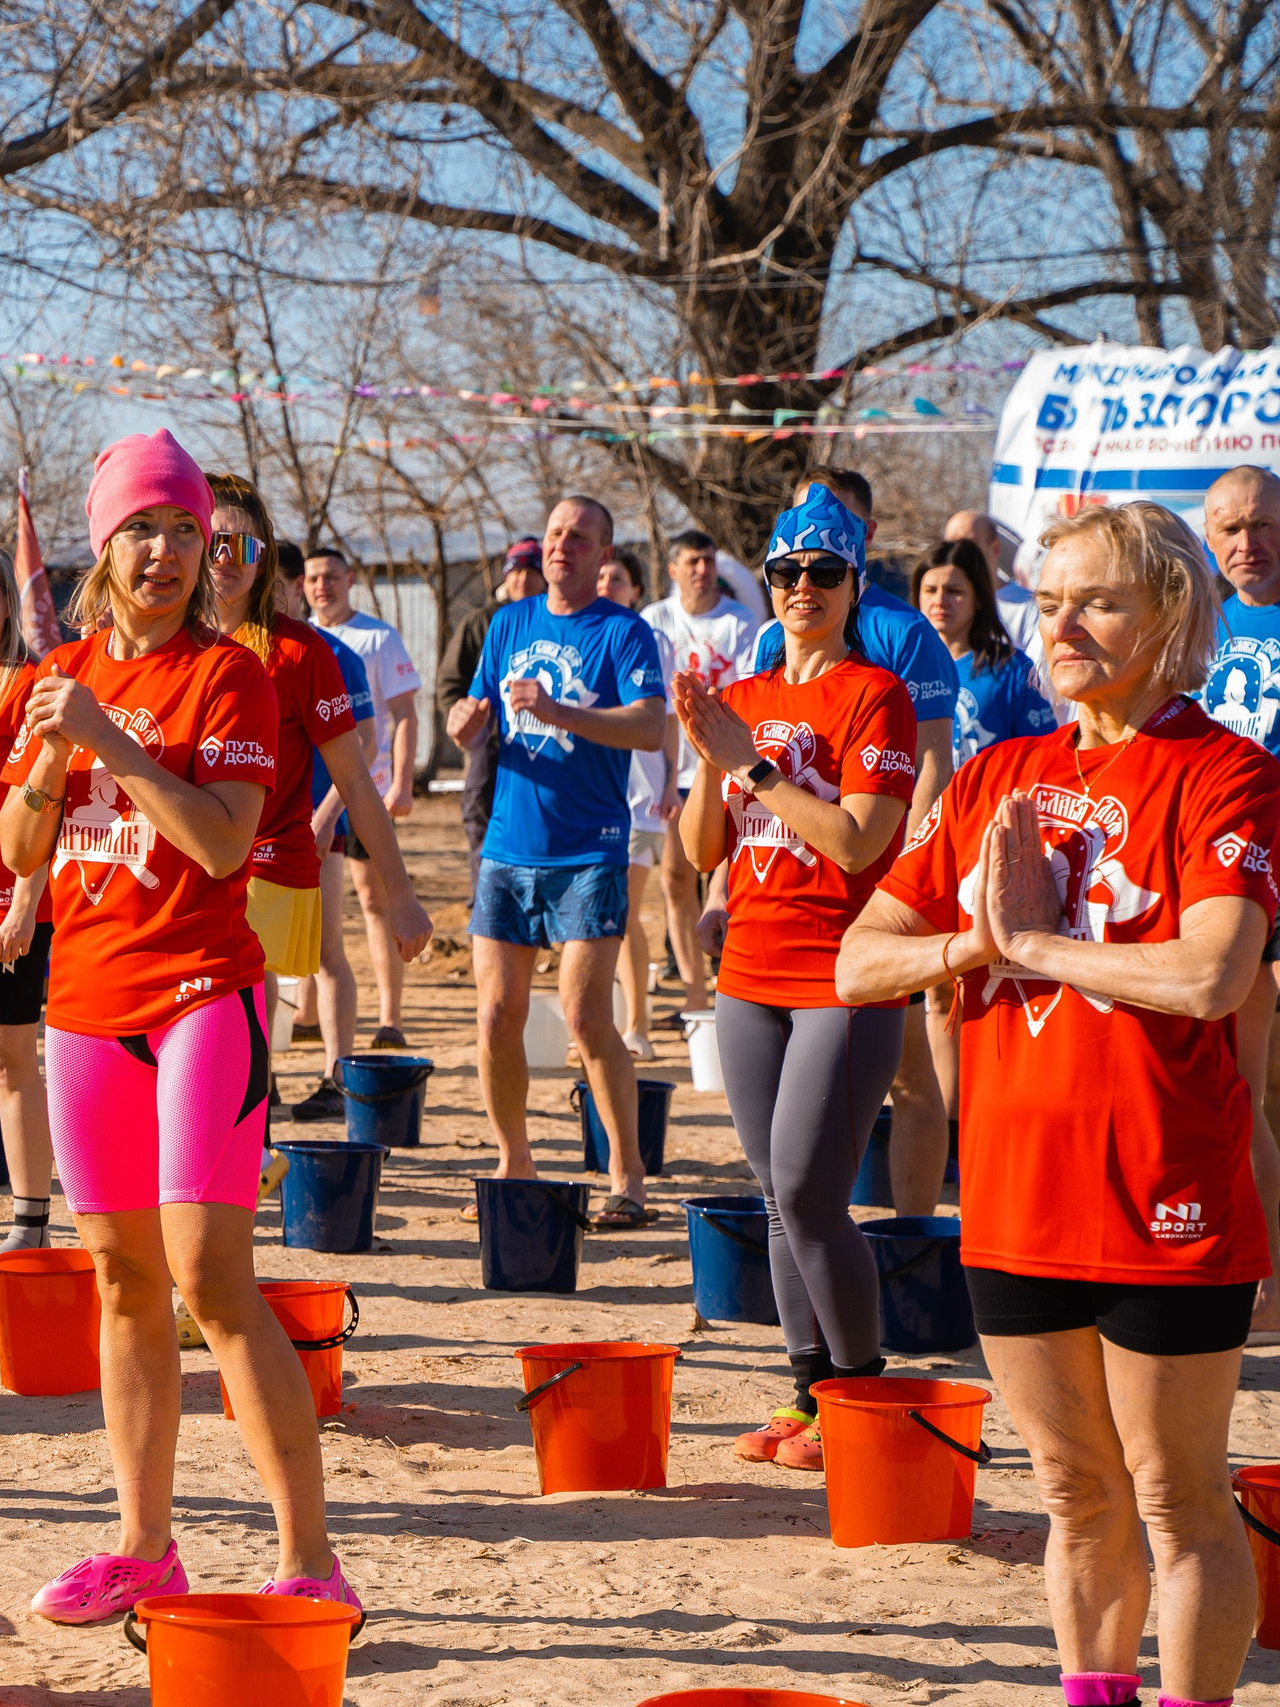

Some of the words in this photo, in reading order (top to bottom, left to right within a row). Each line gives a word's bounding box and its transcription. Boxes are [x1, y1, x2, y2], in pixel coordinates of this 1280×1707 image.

[762, 723, 791, 742] СЛАВА
[225, 740, 264, 754] ПУТЬ
[224, 751, 275, 769] ДОМОЙ
[881, 749, 911, 763] ПУТЬ
[1036, 789, 1089, 824] СЛАВА
[179, 977, 212, 993] N1
[1155, 1202, 1202, 1220] N1
[1149, 1221, 1207, 1232] SPORT
